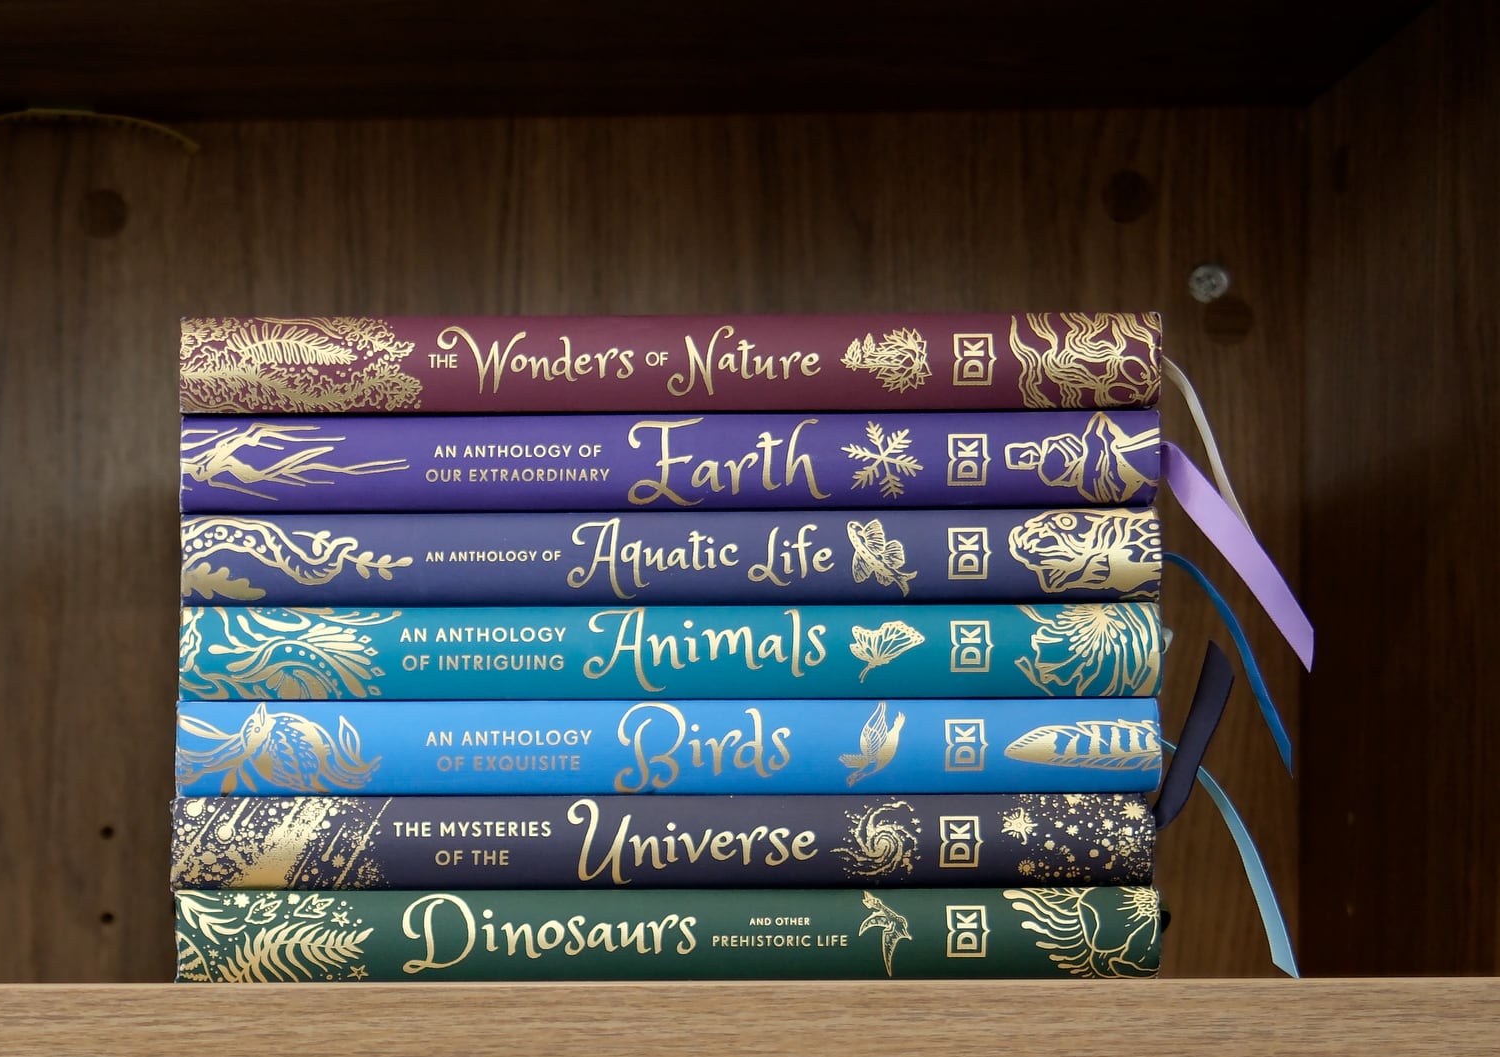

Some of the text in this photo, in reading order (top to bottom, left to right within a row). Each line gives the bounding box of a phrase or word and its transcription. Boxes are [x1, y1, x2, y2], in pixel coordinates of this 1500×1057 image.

[428, 325, 821, 396] THE Wonders OF Nature
[434, 444, 602, 458] AN ANTHOLOGY OF
[627, 417, 831, 506] Earth
[426, 468, 609, 482] OUR EXTRAORDINARY
[425, 517, 835, 599] AN ANTHOLOGY OF Aquatic Life
[400, 627, 566, 642] AN ANTHOLOGY
[582, 607, 827, 692] Animals
[402, 654, 565, 671] OF INTRIGUING
[426, 729, 593, 746] AN ANTHOLOGY
[613, 702, 791, 794] Birds
[437, 755, 580, 771] OF EXQUISITE
[394, 820, 552, 838] THE MYSTERIES
[567, 799, 818, 885] Universe
[435, 850, 509, 867] OF THE
[749, 917, 810, 927] AND OTHER
[402, 893, 697, 974] Dinosaurs
[712, 934, 848, 948] PREHISTORIC LIFE
